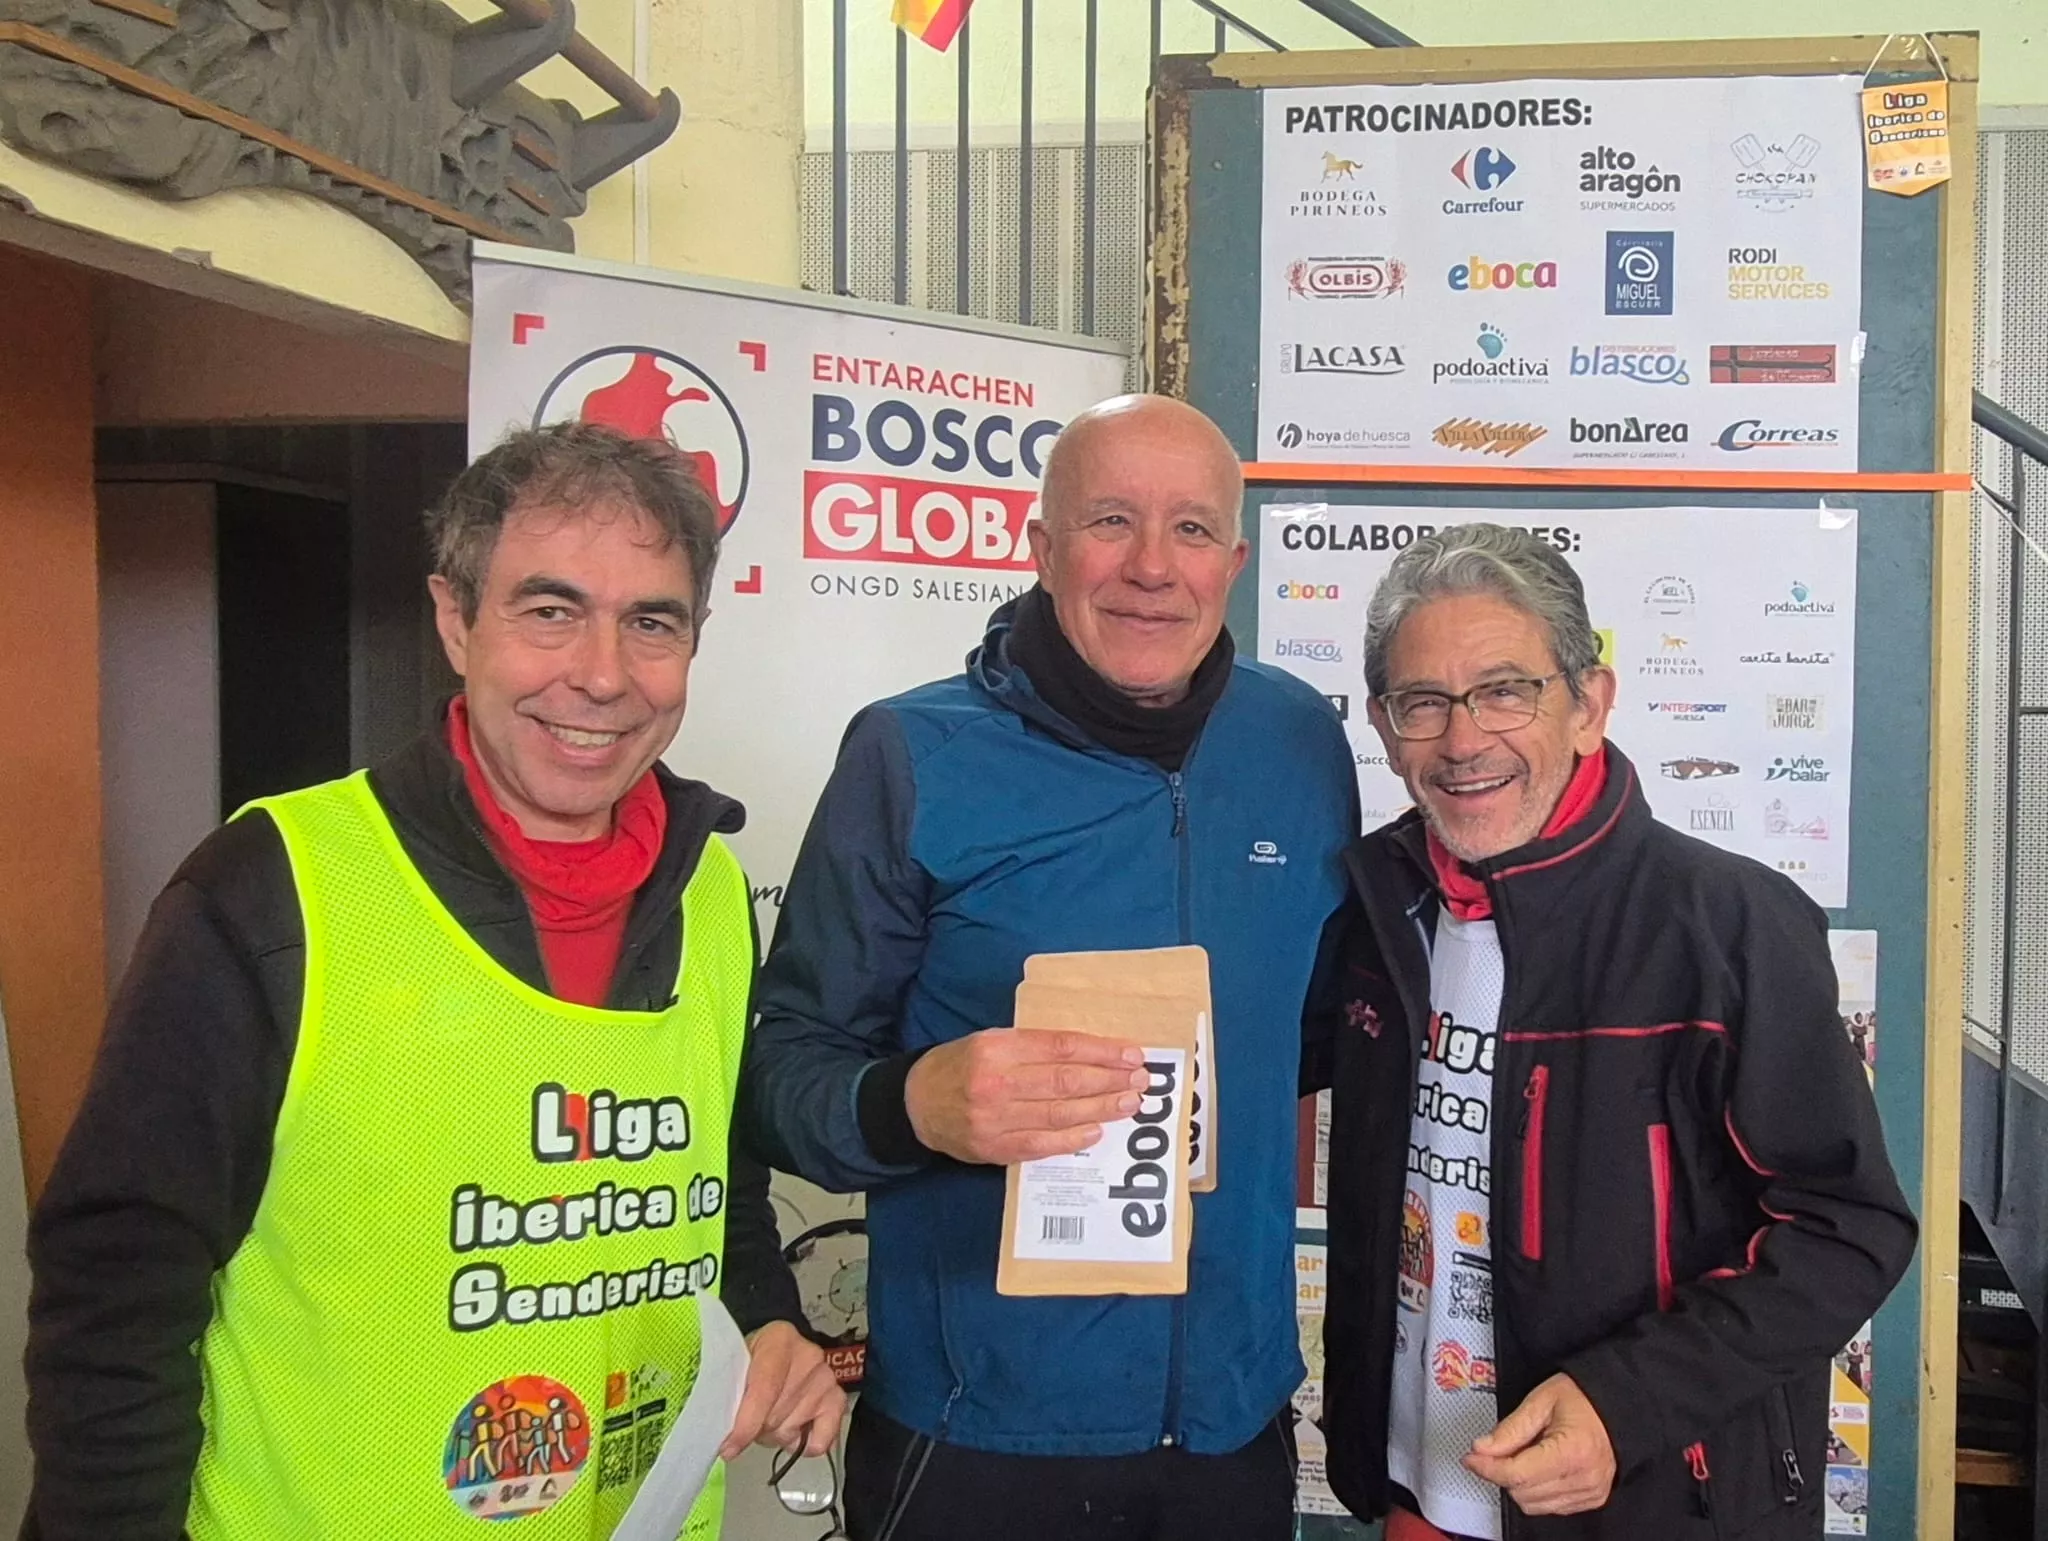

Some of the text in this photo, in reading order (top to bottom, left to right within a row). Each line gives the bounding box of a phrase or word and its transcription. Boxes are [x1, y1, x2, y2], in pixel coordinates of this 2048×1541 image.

[1286, 98, 1592, 133] PATROCINADORES:
[1580, 146, 1636, 170] alto
[1300, 191, 1376, 202] BODEGA
[1290, 205, 1387, 216] PIRINEOS
[1442, 197, 1524, 215] Carrefour
[1580, 201, 1676, 211] SUPERMERCADOS
[1729, 248, 1777, 264] RODI
[1448, 256, 1557, 290] eboca
[1729, 266, 1804, 281] MOTOR
[1616, 283, 1661, 300] MIGUEL
[1729, 283, 1830, 300] SERVICES
[1294, 343, 1406, 375] LACASA
[1570, 345, 1678, 376] blasco
[1433, 357, 1549, 384] podoactiva
[812, 353, 1034, 408] ENTARACHEN
[1306, 428, 1410, 444] hoya de huesca
[1718, 419, 1840, 451] Correas
[811, 574, 900, 598] ONGD
[1277, 580, 1339, 599] eboca
[1764, 601, 1835, 616] podoactiva
[1276, 640, 1337, 658] blasco
[1660, 703, 1727, 713] INTERSPORT
[1790, 756, 1824, 770] vive
[1790, 768, 1831, 783] balar
[1690, 809, 1735, 831] ESENCIA
[532, 1082, 690, 1163] Liga
[450, 1173, 724, 1253] iberica de
